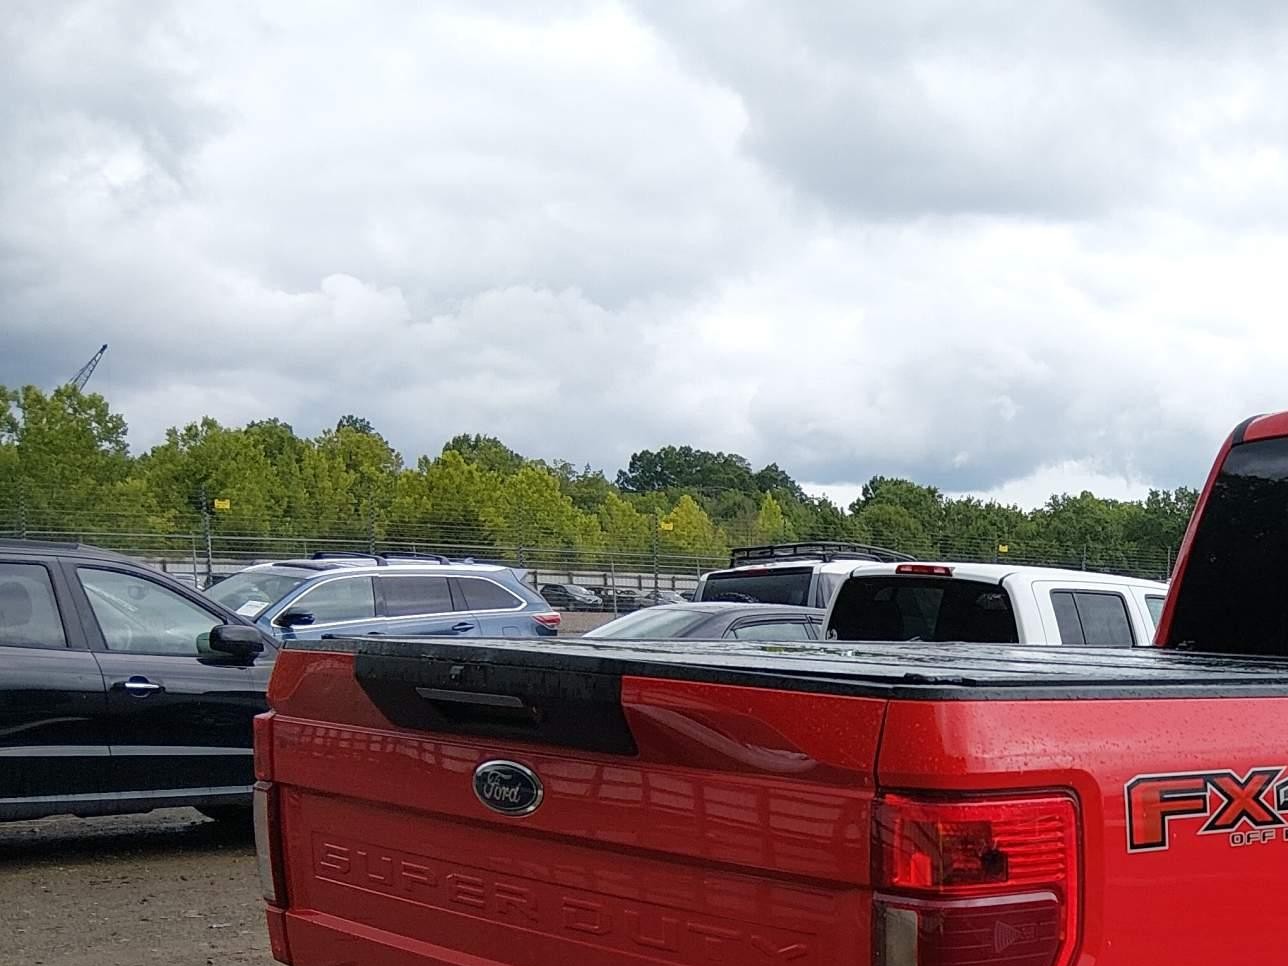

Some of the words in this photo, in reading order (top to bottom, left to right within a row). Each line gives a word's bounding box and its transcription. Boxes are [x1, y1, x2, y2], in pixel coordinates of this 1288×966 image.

[482, 771, 521, 803] Ford
[1230, 829, 1275, 847] OFF
[318, 840, 539, 924] SUPER
